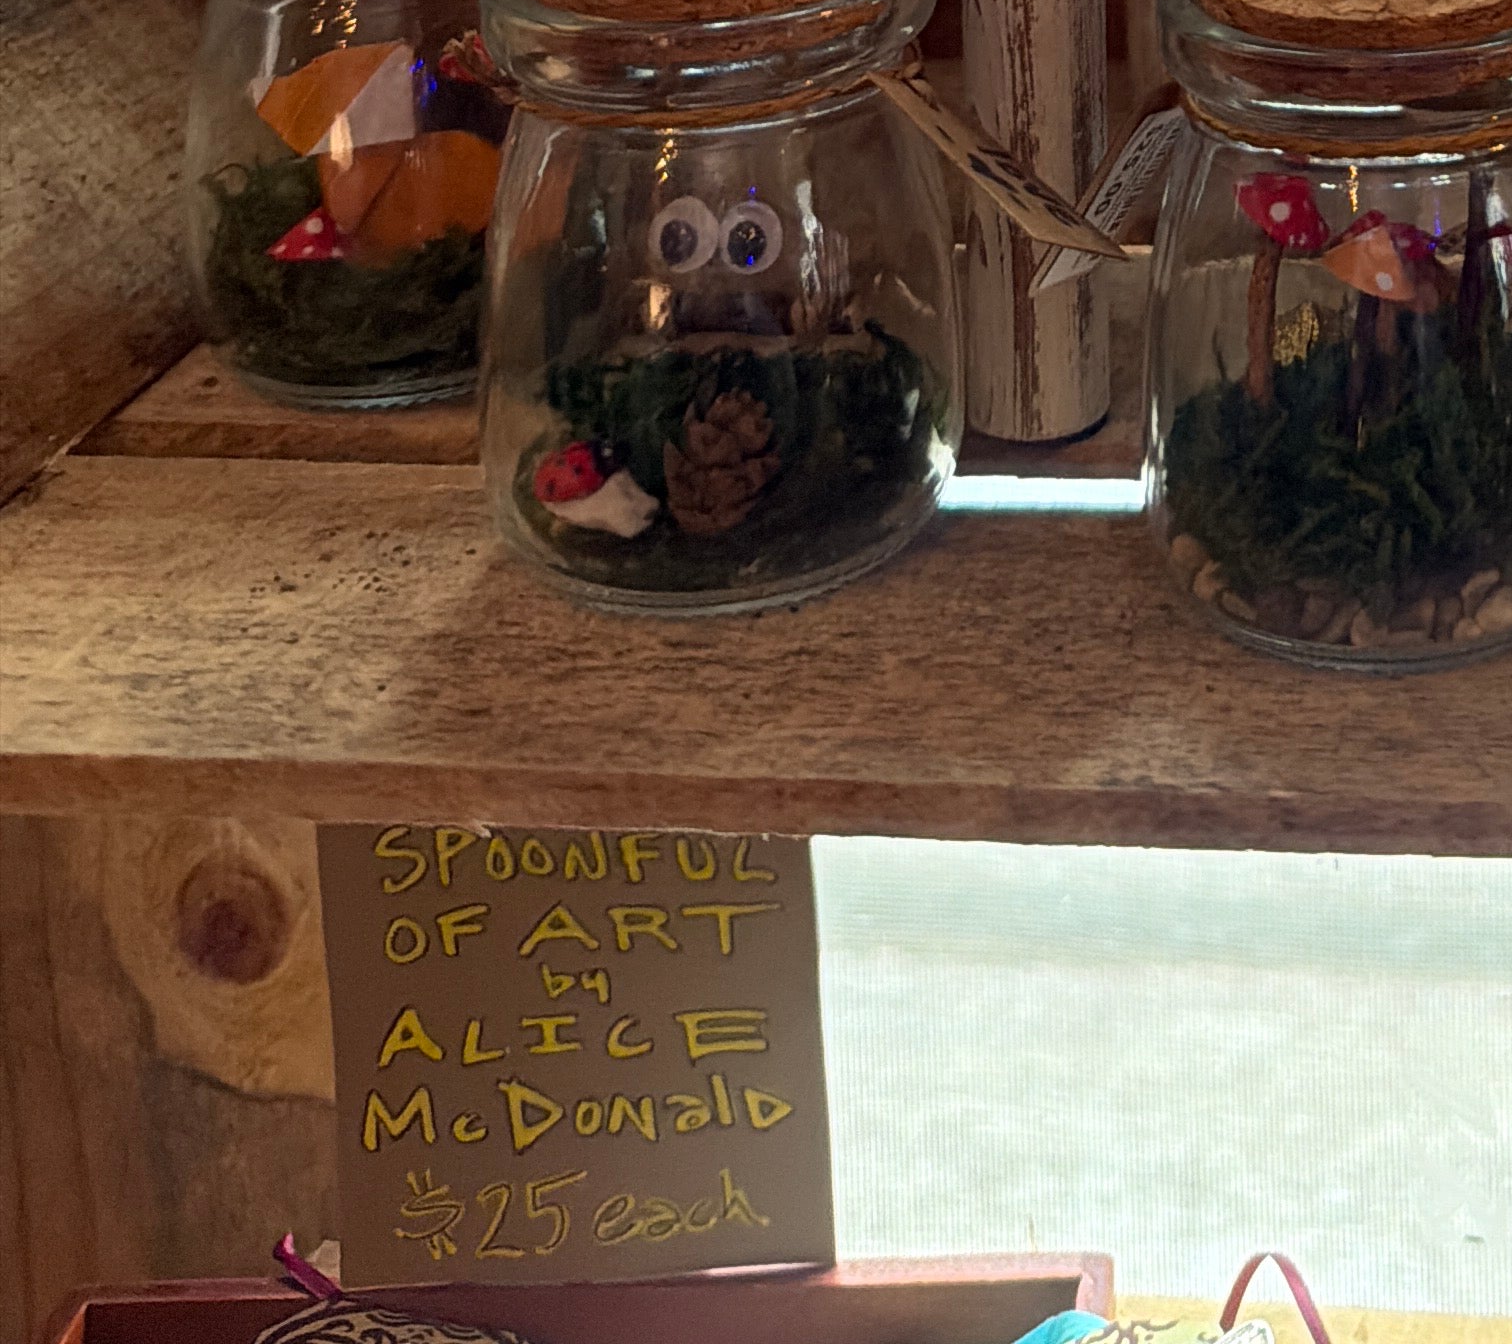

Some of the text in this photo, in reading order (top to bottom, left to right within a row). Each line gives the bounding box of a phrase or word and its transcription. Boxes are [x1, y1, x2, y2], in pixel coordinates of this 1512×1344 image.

[373, 825, 776, 893] SPOONFUL
[384, 900, 781, 964] OF ART
[377, 1006, 769, 1068] ALICE
[394, 1168, 588, 1261] $25
